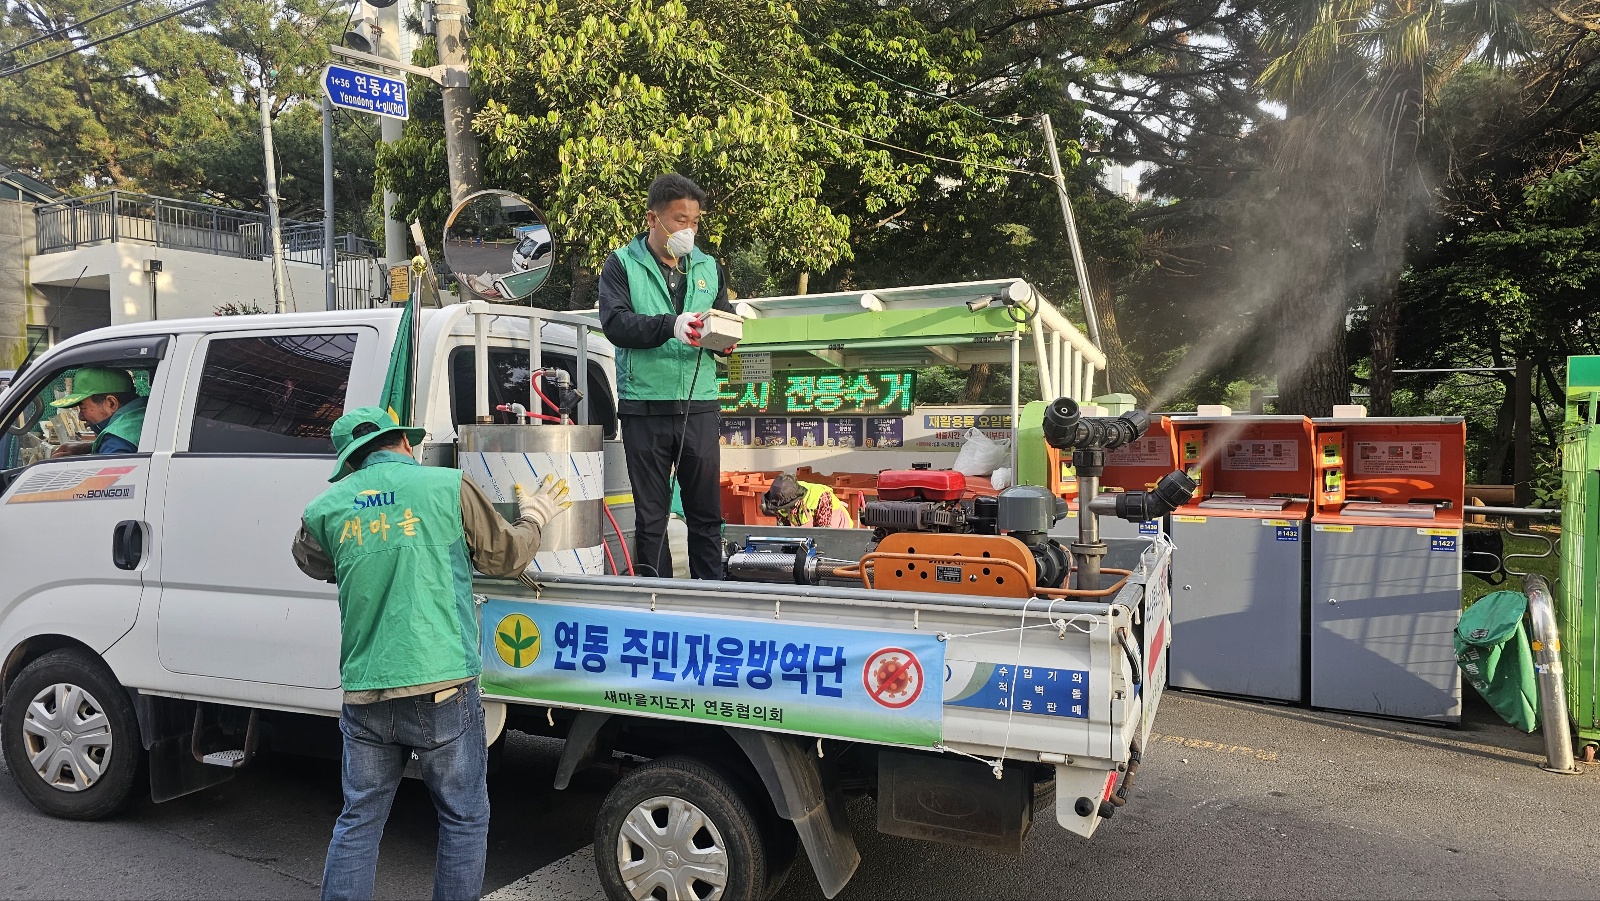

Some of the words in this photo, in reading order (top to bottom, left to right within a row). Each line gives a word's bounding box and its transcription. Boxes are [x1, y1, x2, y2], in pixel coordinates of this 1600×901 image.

[340, 79, 350, 89] 36
[354, 75, 403, 102] 연동4길
[340, 91, 373, 109] Yeondong
[785, 373, 913, 413] 전용수거
[928, 415, 975, 429] 재활용품
[87, 488, 122, 498] BONGO
[353, 490, 396, 511] SMU
[339, 507, 421, 546] 새마을
[554, 620, 609, 673] 연동
[619, 627, 848, 698] 주민자율방역단
[603, 690, 696, 714] 새마을지도자
[702, 699, 785, 724] 연동협의회
